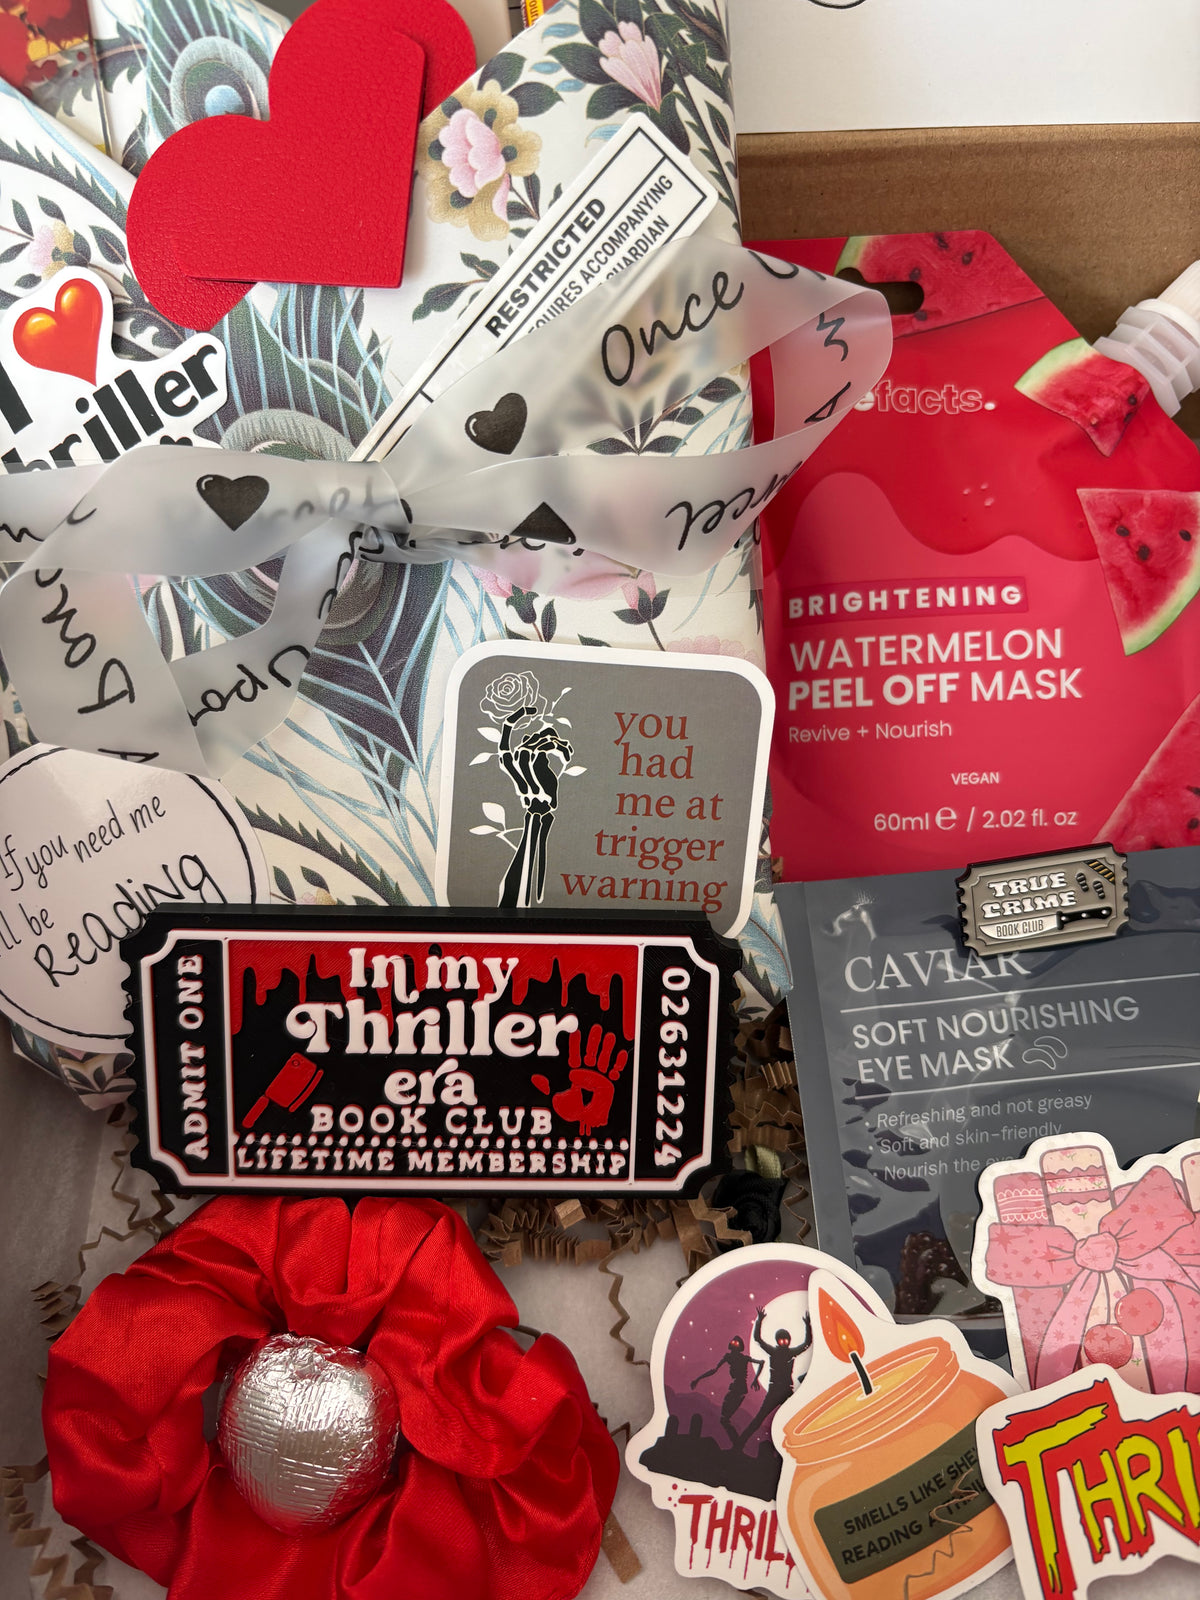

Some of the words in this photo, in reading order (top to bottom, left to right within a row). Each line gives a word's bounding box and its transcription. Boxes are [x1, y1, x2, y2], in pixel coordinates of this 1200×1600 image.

[580, 175, 673, 285] ACCOMPANYING
[485, 199, 606, 338] RESTRICTED
[601, 271, 745, 386] Once
[788, 585, 1022, 619] BRIGHTENING
[789, 628, 1062, 672] WATERMELON
[788, 676, 873, 711] PEEL
[882, 672, 960, 706] OFF
[970, 668, 1083, 702] MASK
[613, 712, 689, 746] you
[788, 726, 851, 743] Revive
[875, 719, 953, 740] Nourish
[618, 742, 694, 779] had
[951, 772, 1000, 785] VEGAN
[615, 793, 675, 818] me
[686, 793, 724, 820] at
[874, 813, 929, 831] 60ml
[982, 810, 1026, 828] 2.02
[1054, 811, 1078, 826] oz
[0, 834, 24, 891] If
[25, 835, 69, 889] you
[74, 799, 125, 863] need
[130, 796, 166, 833] me
[594, 825, 724, 871] trigger
[560, 870, 728, 914] warning
[981, 890, 1077, 919] CRIME
[988, 872, 1067, 898] TRUE
[19, 903, 54, 936] be
[996, 923, 1020, 937] BOOK
[1022, 919, 1044, 933] CLUB
[177, 954, 204, 1030] ONE
[349, 947, 419, 1003] In
[426, 955, 519, 1004] my
[844, 949, 1031, 992] CAVIAR
[286, 998, 579, 1057] Thriller
[852, 1018, 927, 1049] SOFT
[937, 996, 1140, 1041] NOURISHING
[384, 1058, 478, 1105] era
[654, 967, 691, 1167] 02631224
[857, 1054, 913, 1084] EYE
[920, 1042, 1015, 1078] MASK
[179, 1041, 209, 1160] ADMIT
[310, 1105, 427, 1134] BOOK
[445, 1106, 552, 1135] CLUB
[877, 1106, 966, 1129] Refreshing
[971, 1101, 1001, 1117] and
[1006, 1098, 1034, 1114] not
[1038, 1094, 1093, 1115] greasy
[237, 1147, 394, 1173] LIFETIME
[408, 1150, 626, 1175] MEMBERSHIP
[880, 1136, 915, 1155] Soft
[919, 1133, 950, 1150] and
[884, 1161, 948, 1181] Nourish
[954, 1157, 980, 1173] the
[843, 1496, 909, 1535] SMELLS
[909, 1473, 947, 1505] LIKE
[1002, 1402, 1200, 1595] THRI
[678, 1494, 797, 1580] THRIL
[842, 1519, 923, 1565] READING
